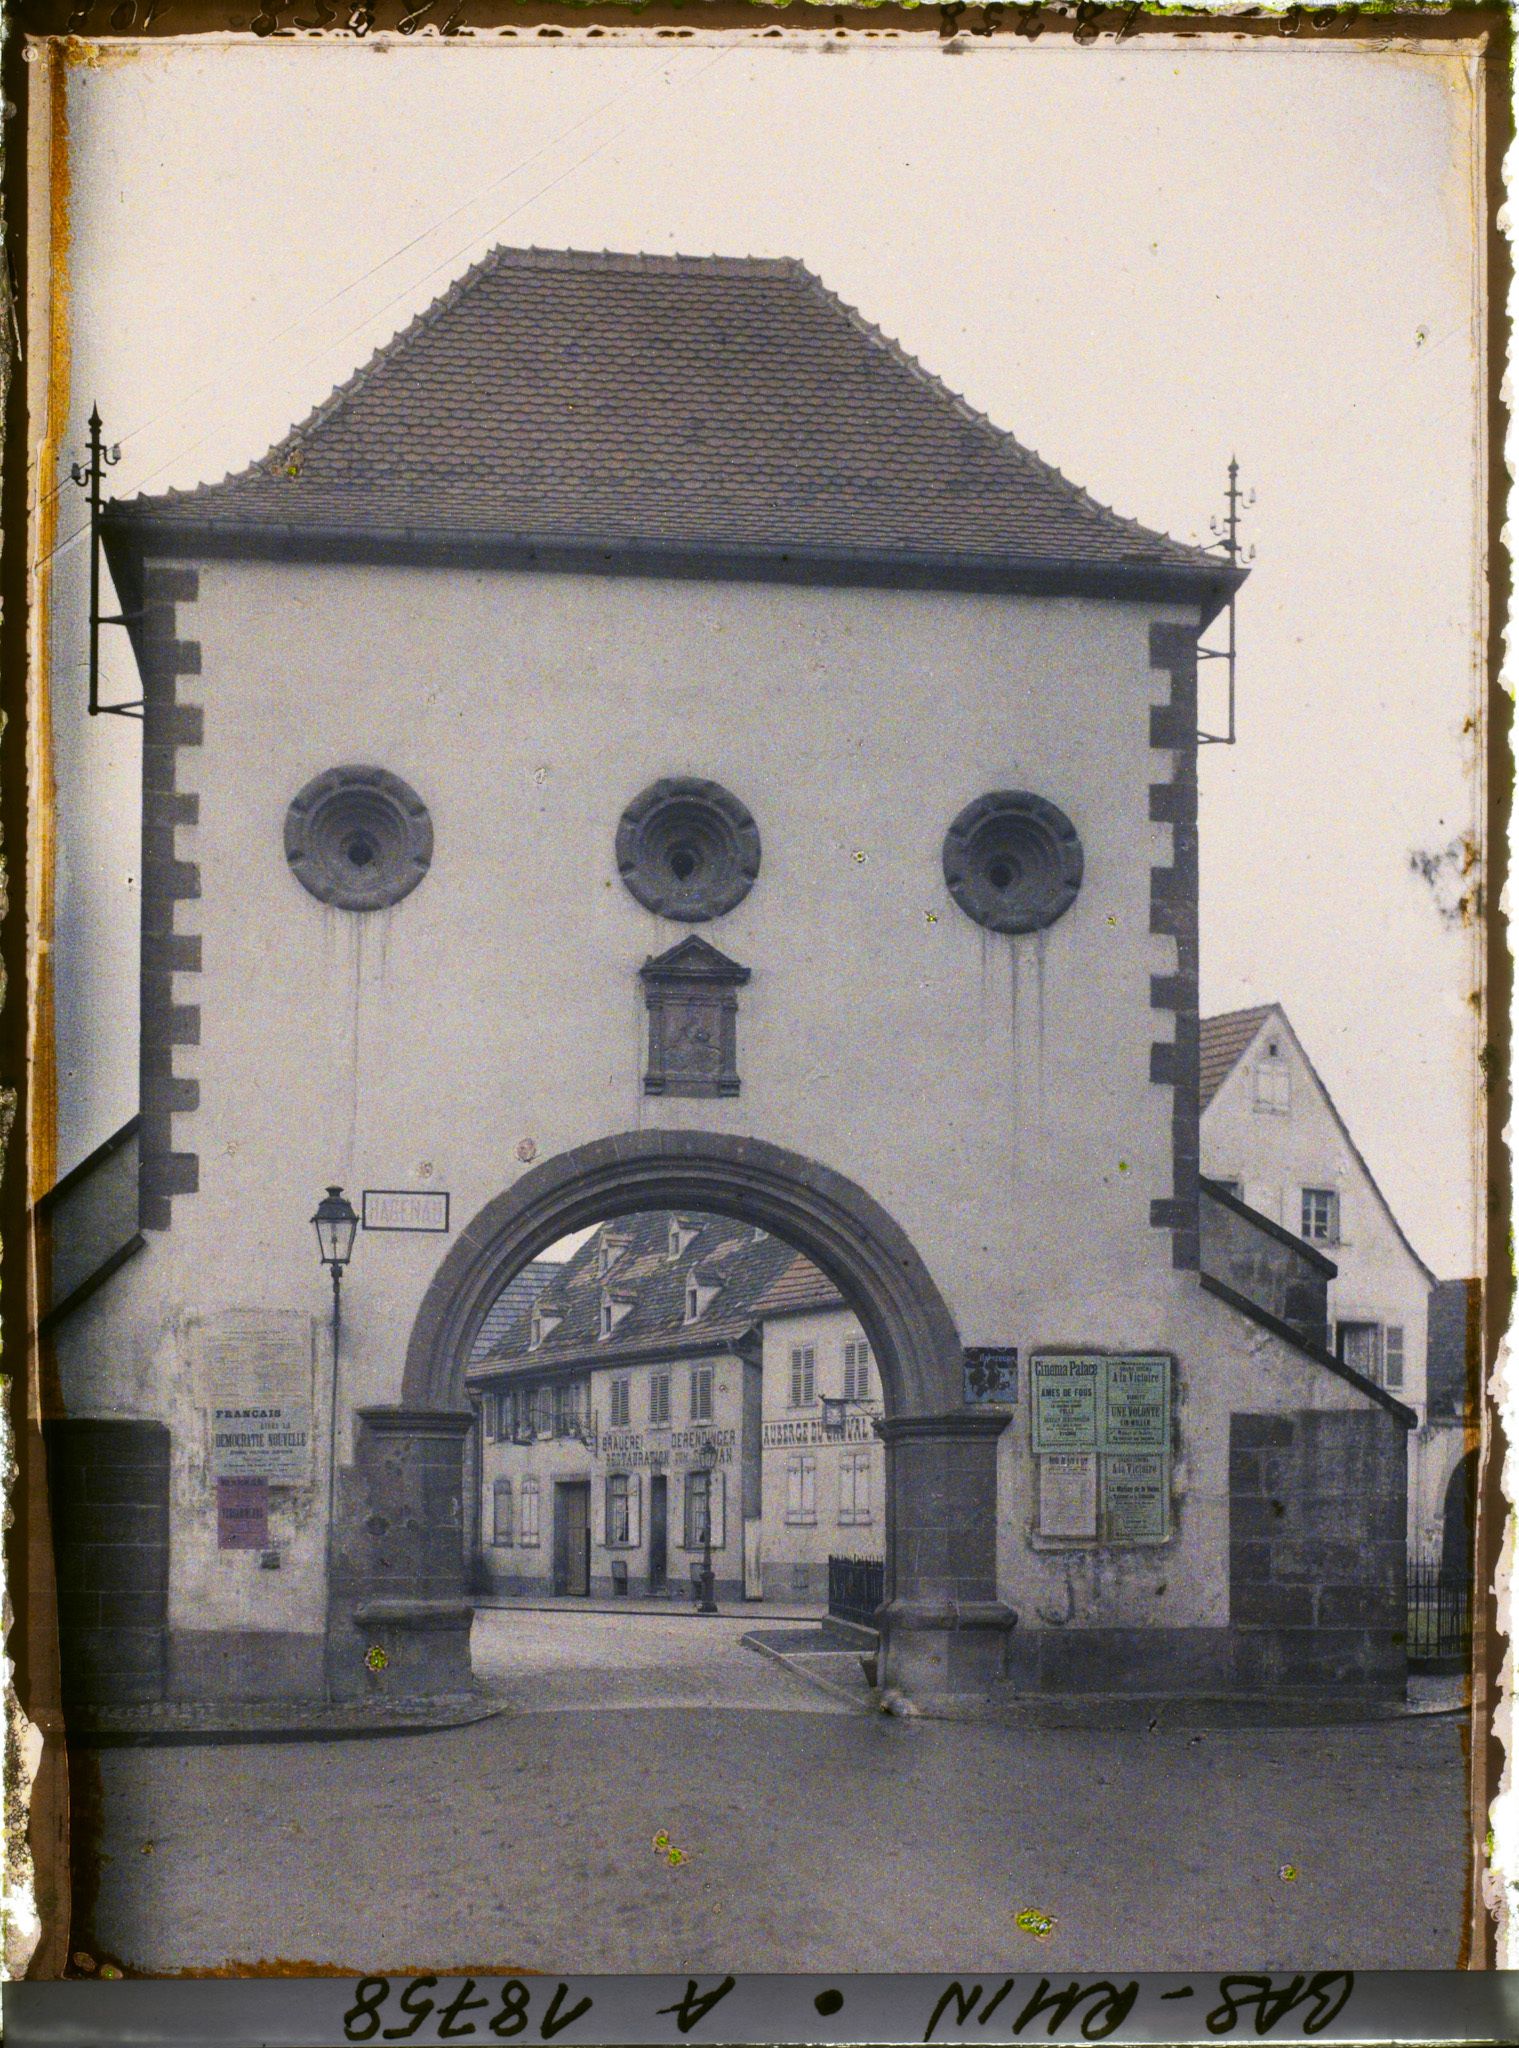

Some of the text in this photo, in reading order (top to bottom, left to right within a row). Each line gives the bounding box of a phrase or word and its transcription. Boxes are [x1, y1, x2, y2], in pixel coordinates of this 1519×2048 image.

[1069, 1361, 1098, 1377] Palace
[1128, 1372, 1159, 1383] Victoire
[763, 1421, 810, 1446] AUBERGE
[343, 1976, 593, 2041] 18758
[657, 1976, 736, 2033] A
